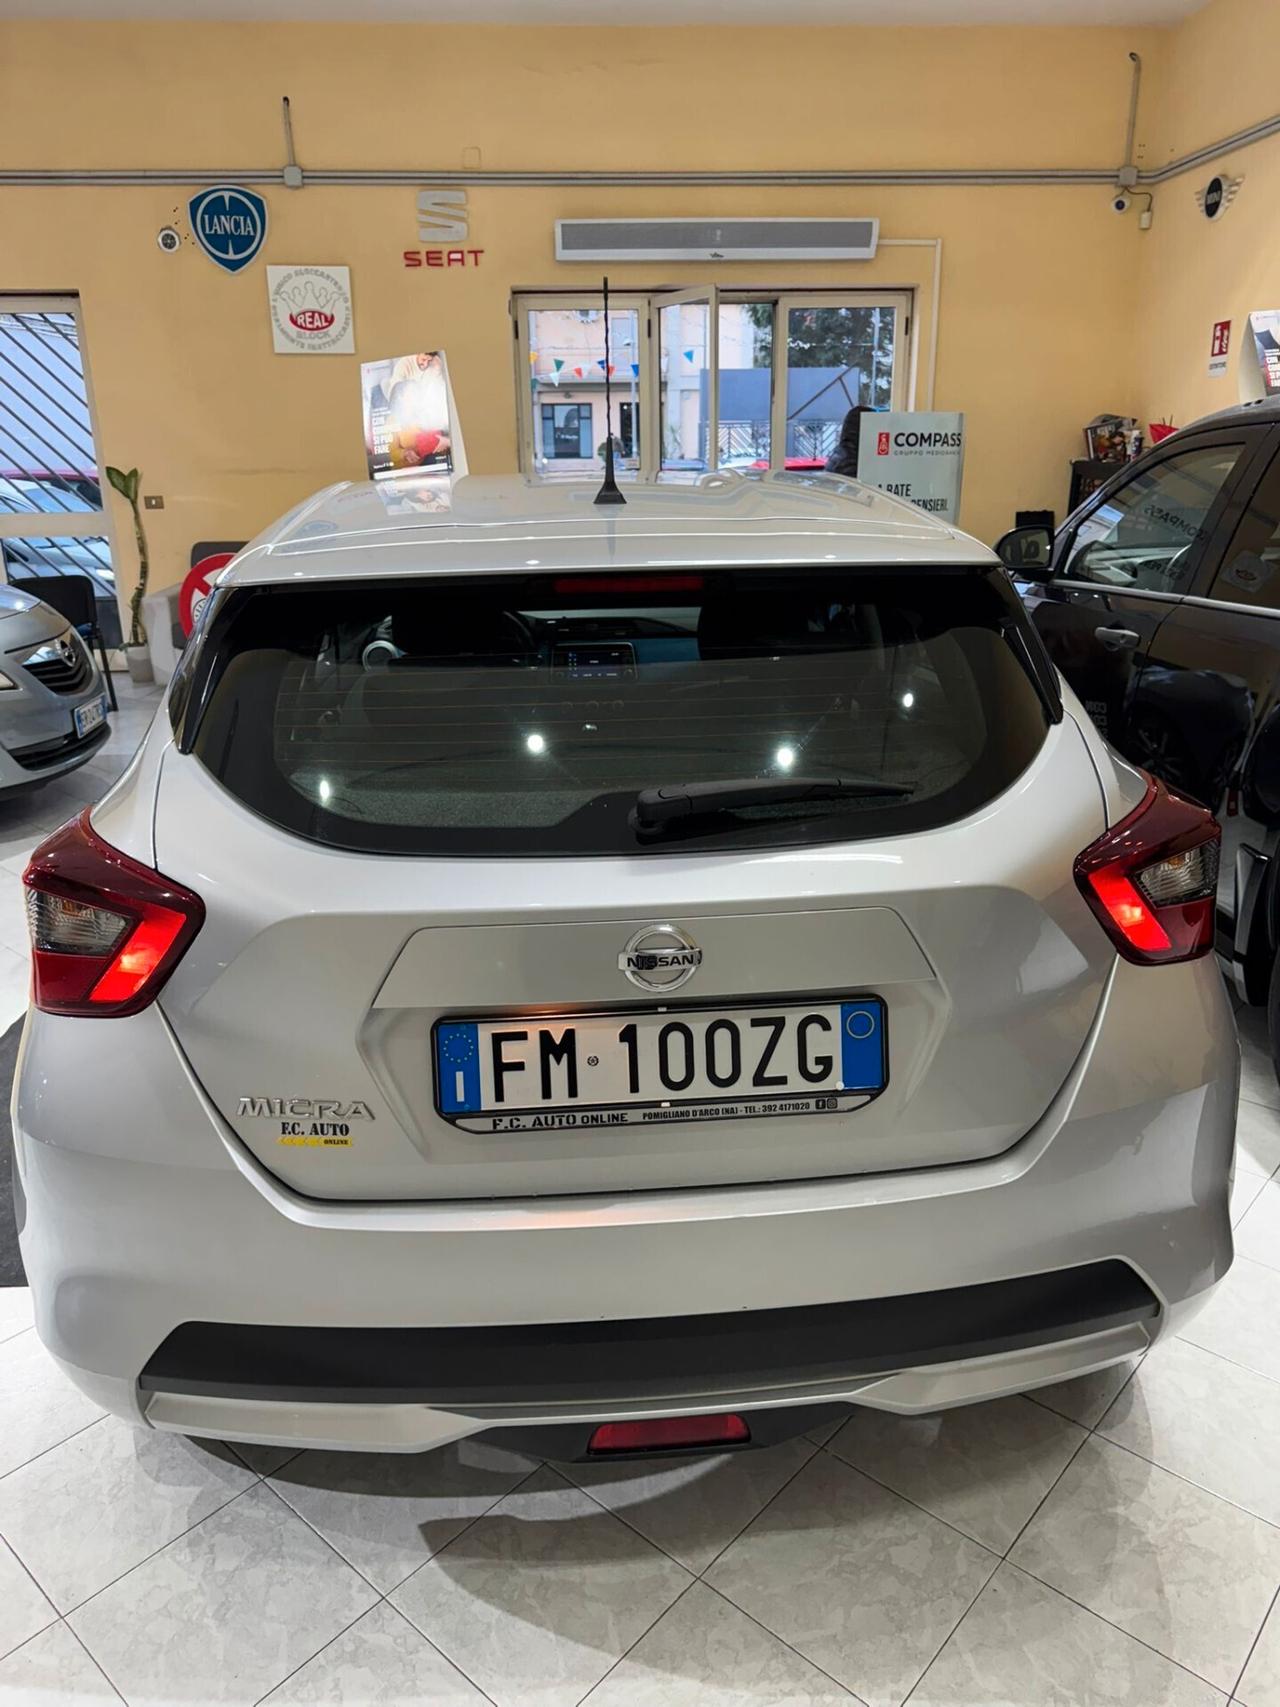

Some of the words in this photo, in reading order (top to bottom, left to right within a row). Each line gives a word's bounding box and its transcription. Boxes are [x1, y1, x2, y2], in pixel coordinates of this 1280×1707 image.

[203, 214, 255, 236] LANCIA
[403, 250, 484, 267] SEAT
[297, 311, 330, 329] REAL
[894, 432, 961, 447] COMPASS
[490, 1027, 578, 1103] FM
[618, 1013, 834, 1094] 100ZG
[236, 1097, 376, 1121] MICRA
[642, 1110, 691, 1121] POMIGLIANO
[691, 1107, 721, 1119] D'ARCO
[762, 1103, 778, 1113] 392
[280, 1121, 305, 1136] F.C.
[309, 1122, 350, 1136] AUTO
[492, 1117, 526, 1131] F.C.
[531, 1113, 577, 1128] AUTO
[580, 1112, 629, 1125] ONLINE
[323, 1138, 349, 1146] ONLINE
